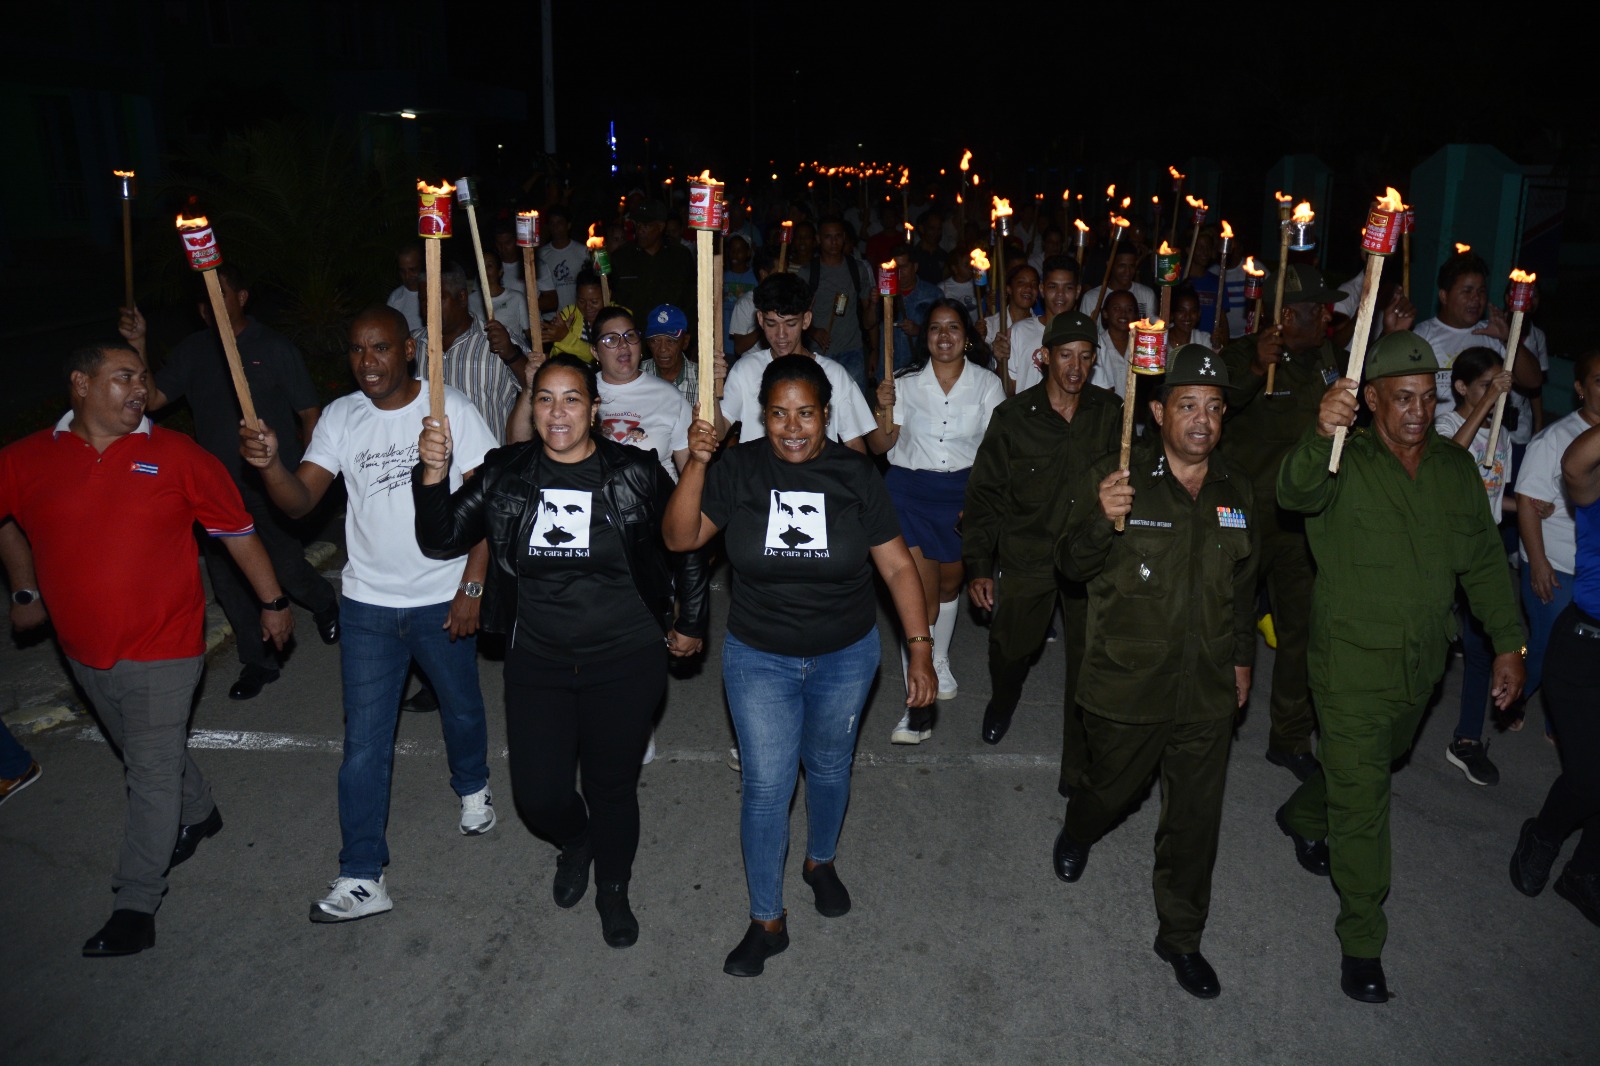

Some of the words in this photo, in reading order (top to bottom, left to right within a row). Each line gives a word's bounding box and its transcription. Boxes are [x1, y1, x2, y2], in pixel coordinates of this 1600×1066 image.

[528, 547, 542, 557] De
[564, 549, 573, 558] al
[575, 548, 590, 558] Sol
[764, 548, 778, 557] De
[781, 550, 801, 558] cara
[803, 549, 812, 558] al
[814, 549, 830, 559] Sol
[350, 885, 371, 902] N
